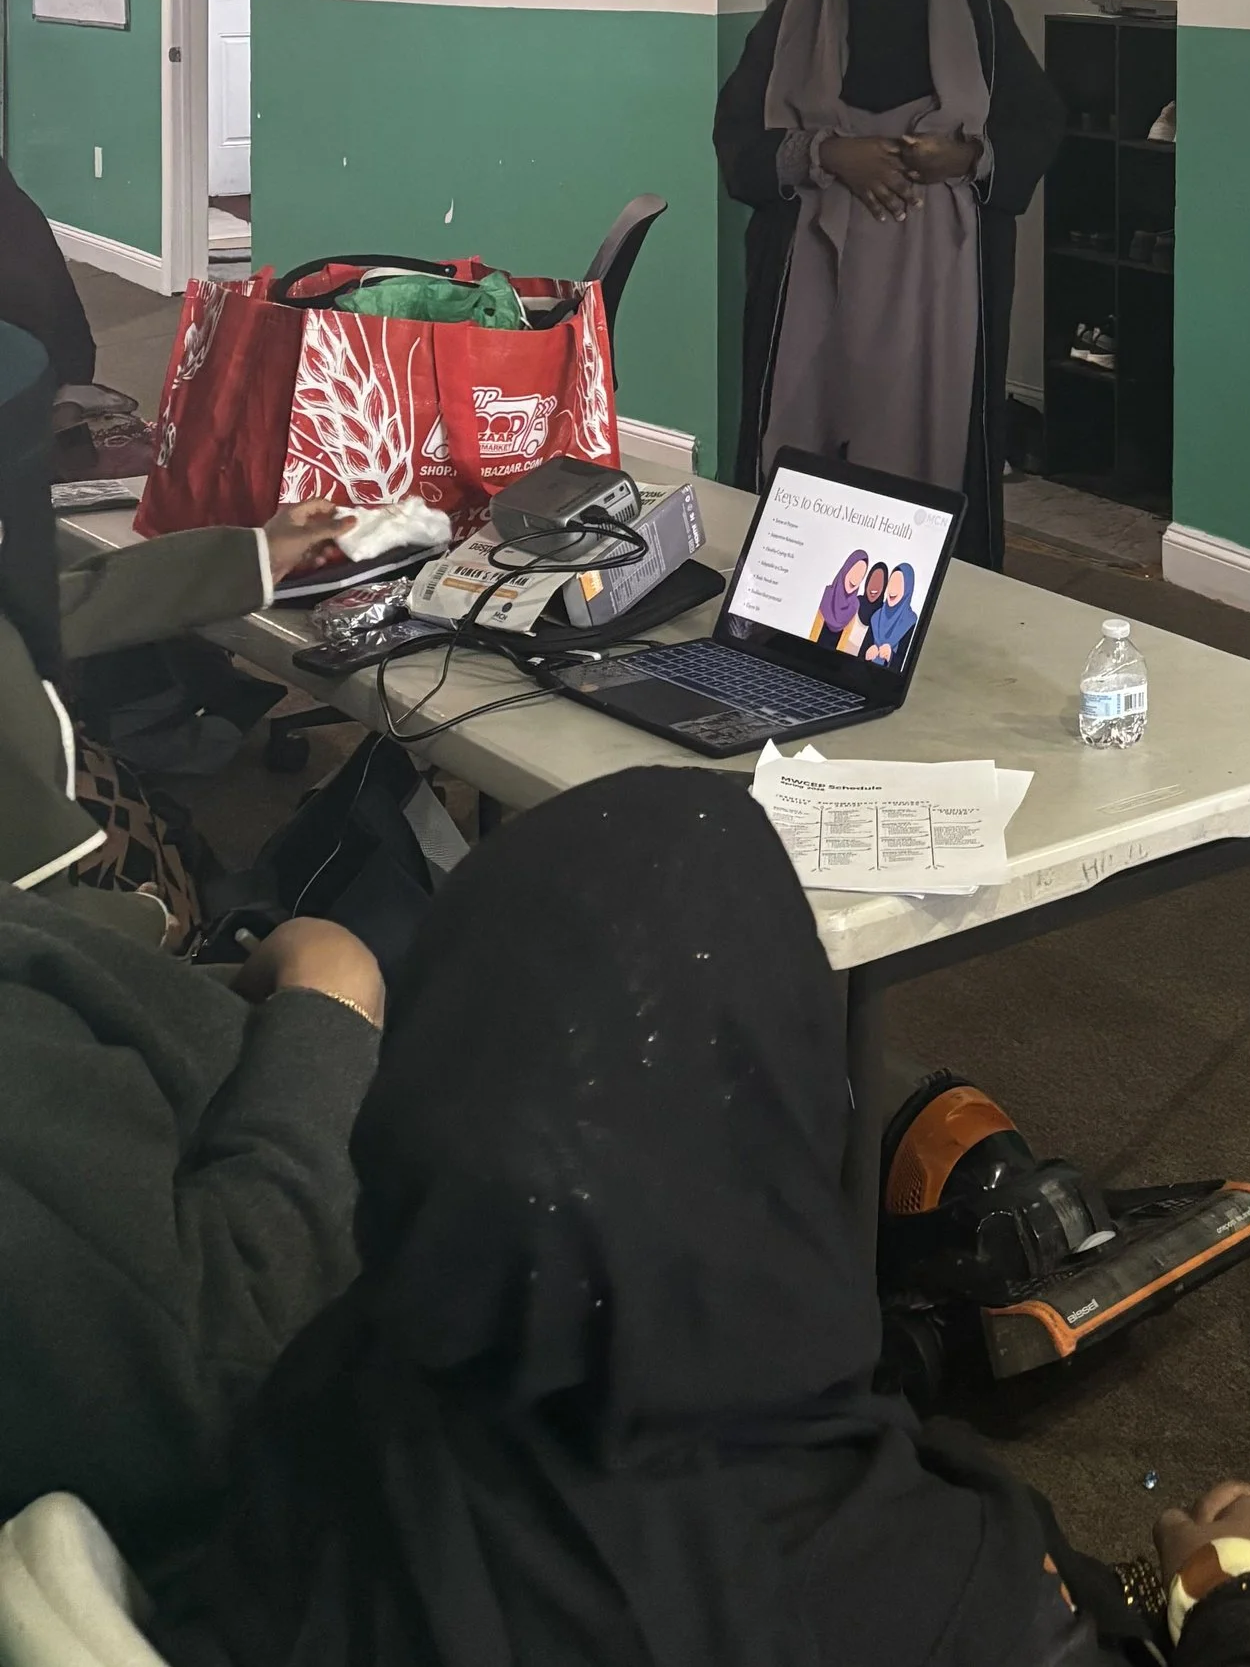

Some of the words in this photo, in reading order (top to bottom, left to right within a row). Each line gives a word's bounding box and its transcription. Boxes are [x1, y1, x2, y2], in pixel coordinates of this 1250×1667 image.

[774, 487, 800, 509] Keys
[800, 496, 812, 510] to
[813, 498, 843, 519] Good
[841, 506, 879, 529] Mental
[878, 516, 913, 540] Health
